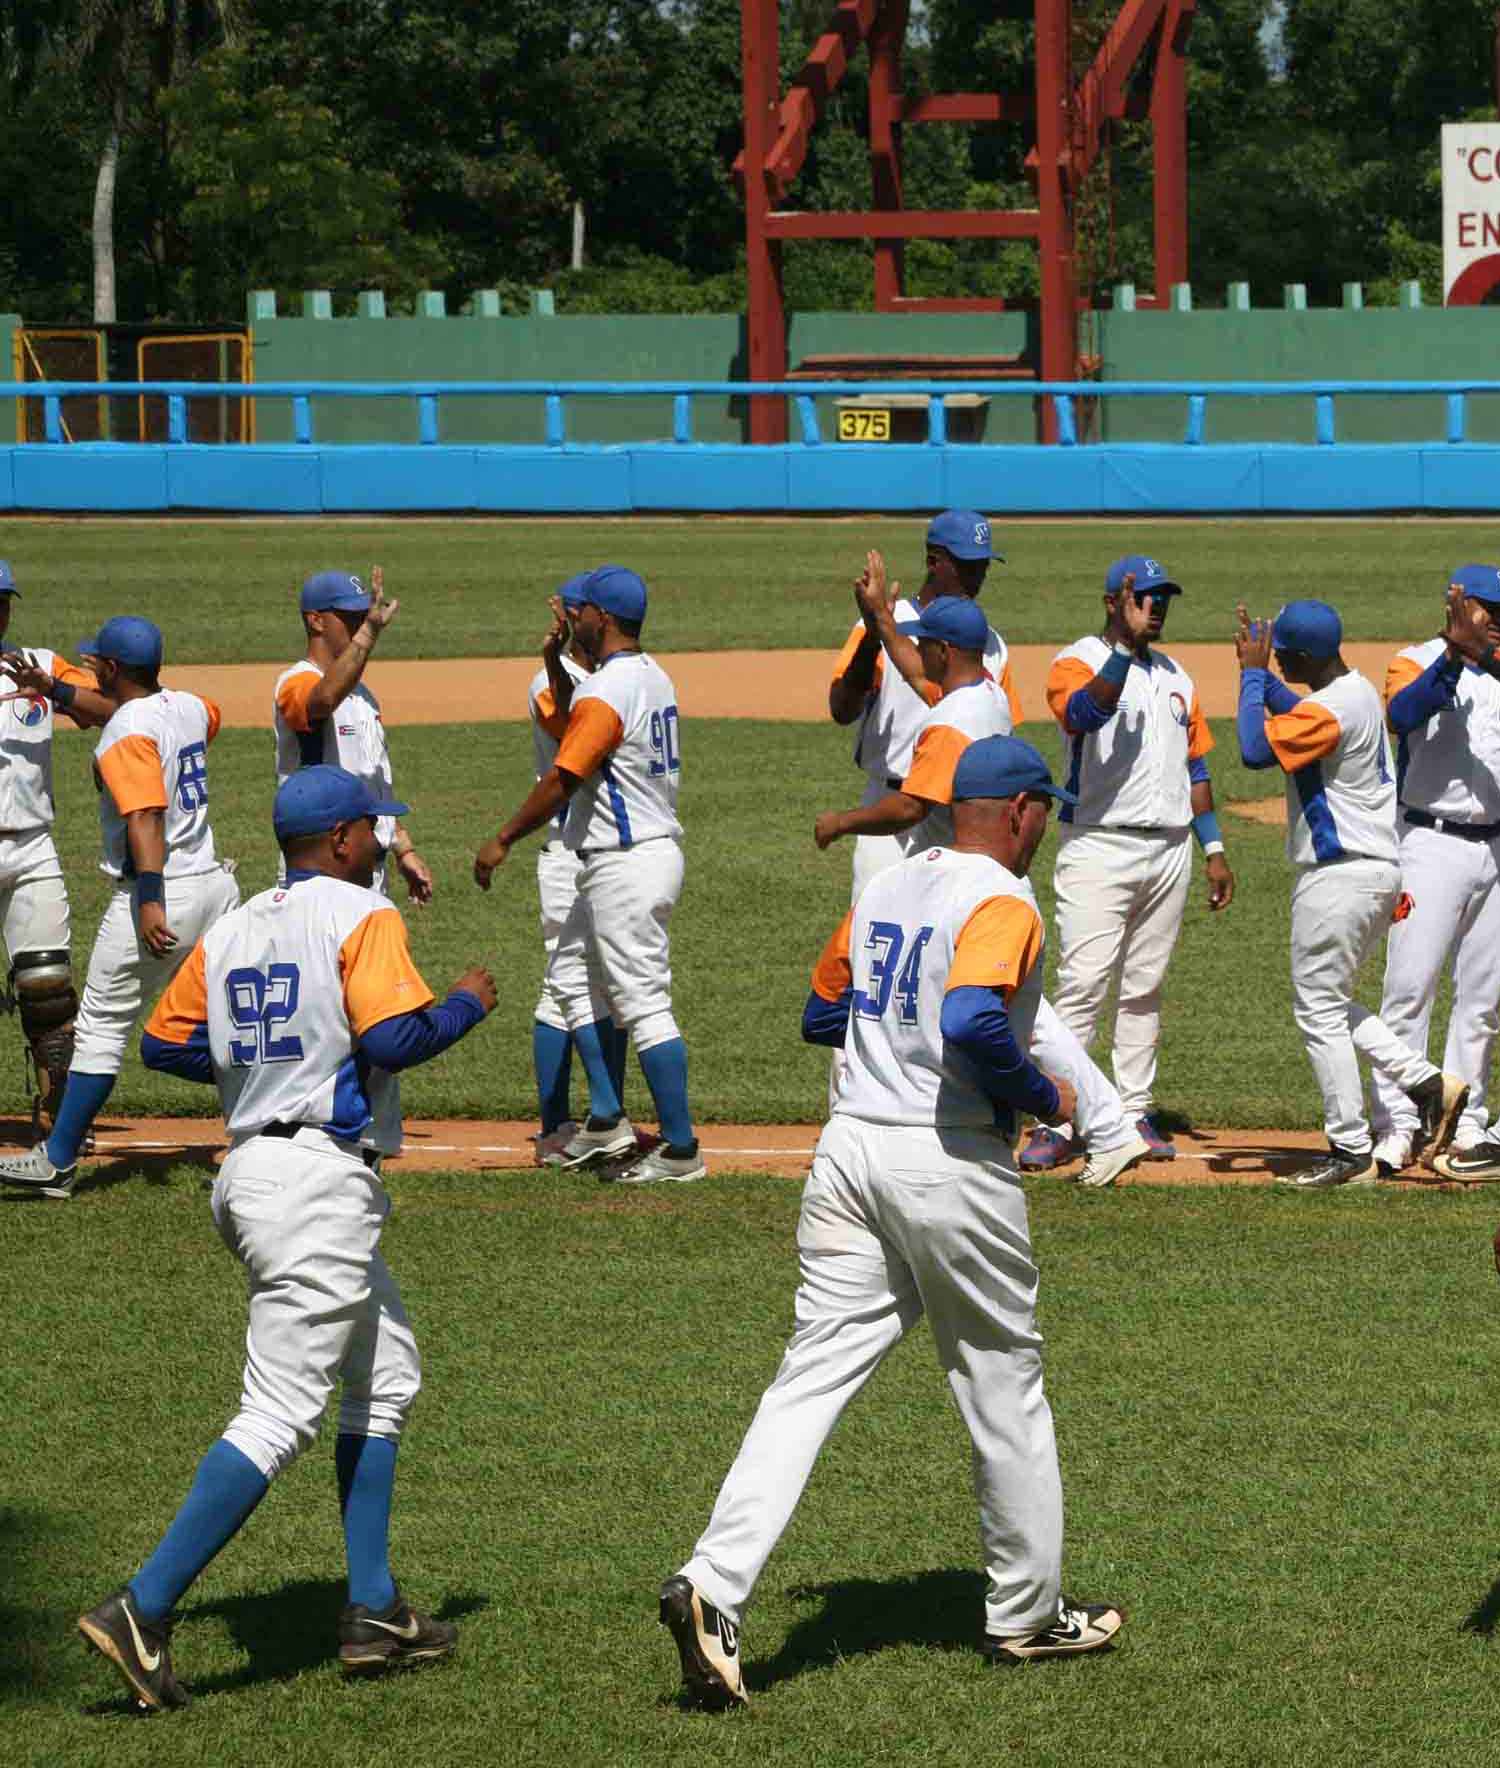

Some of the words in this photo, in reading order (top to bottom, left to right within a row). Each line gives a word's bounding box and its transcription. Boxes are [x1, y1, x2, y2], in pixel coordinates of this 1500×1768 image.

[843, 413, 887, 437] 375
[224, 961, 305, 1068] 92
[852, 919, 935, 1026] 34
